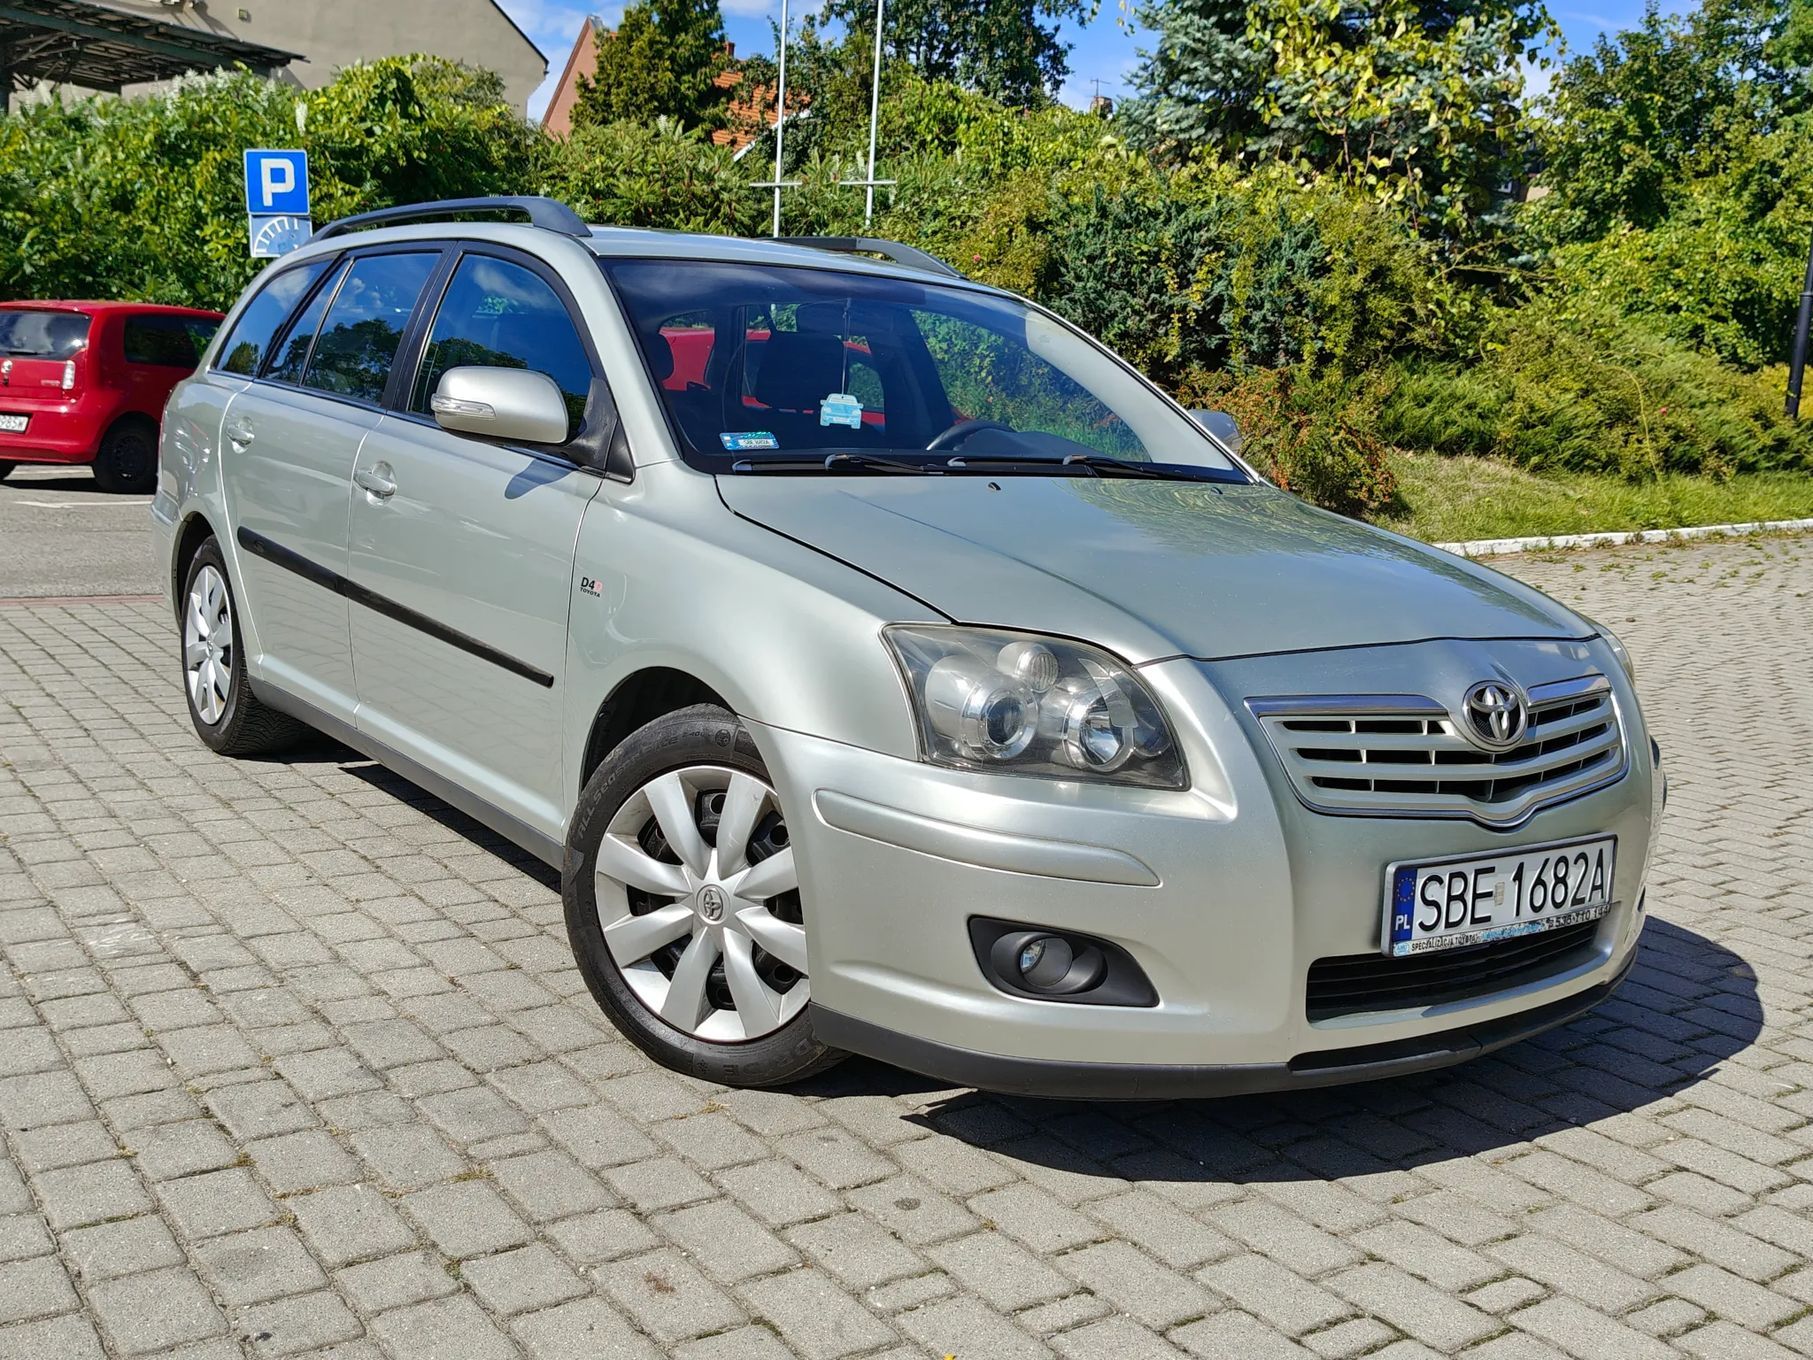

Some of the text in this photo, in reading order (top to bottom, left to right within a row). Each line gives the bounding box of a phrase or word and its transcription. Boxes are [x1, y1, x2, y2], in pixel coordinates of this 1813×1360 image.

[261, 158, 295, 206] P
[579, 587, 601, 598] TOYOTA
[1417, 848, 1605, 932] SBE 1682A
[1394, 914, 1411, 931] PL
